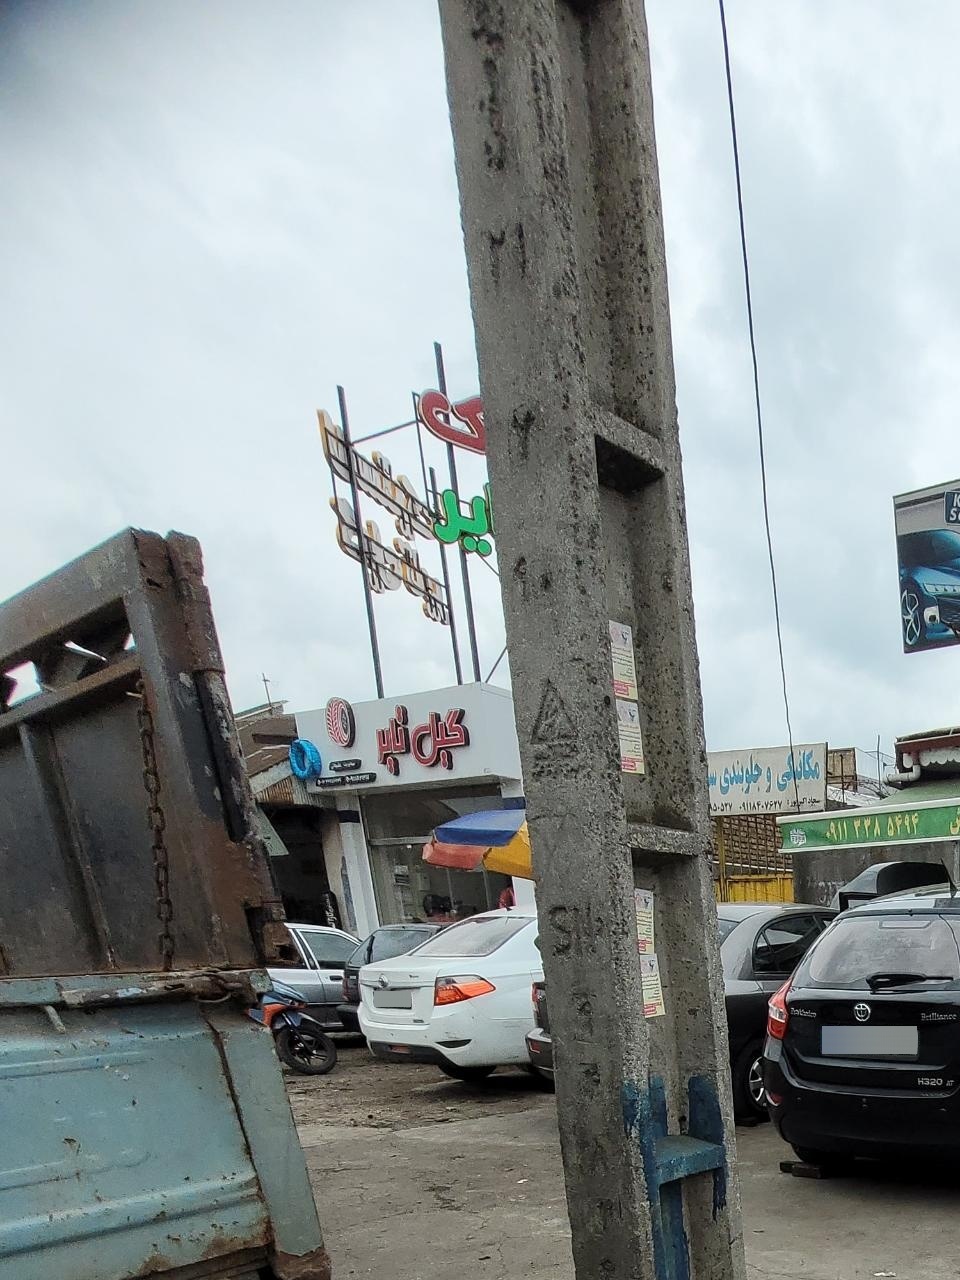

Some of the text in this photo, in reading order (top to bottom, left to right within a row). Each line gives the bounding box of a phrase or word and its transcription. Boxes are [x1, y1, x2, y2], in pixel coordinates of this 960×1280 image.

[720, 754, 762, 795] جلوبندی
[765, 766, 772, 793] و
[921, 1012, 957, 1022] Brilliance
[917, 1077, 943, 1086] H320
